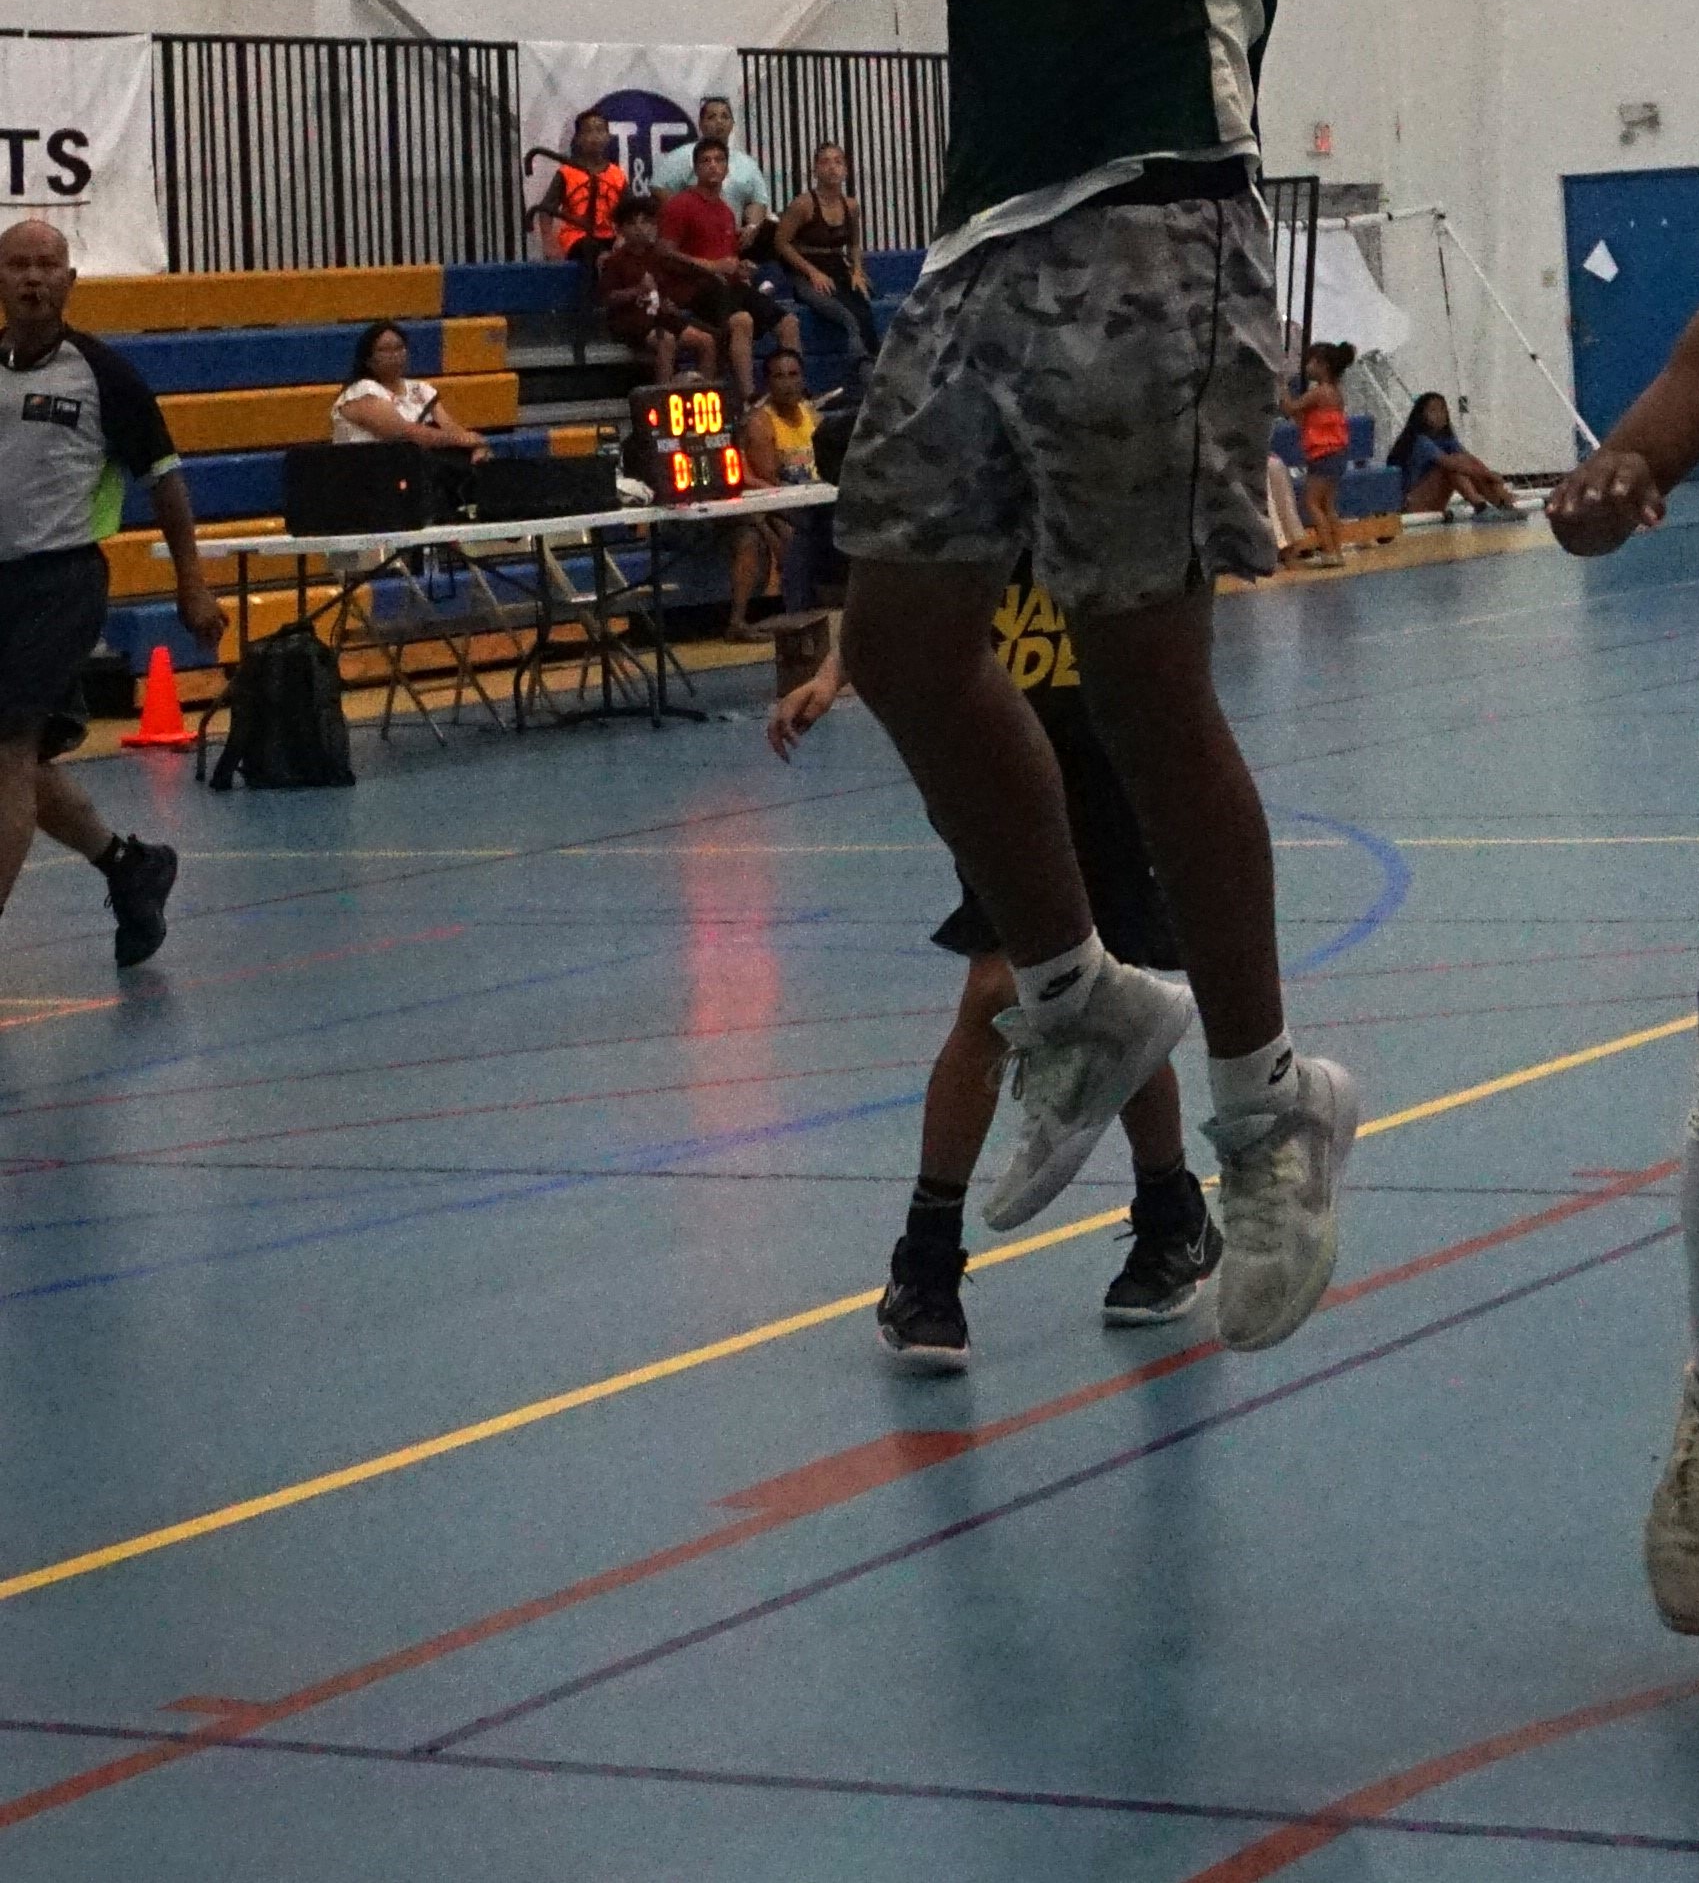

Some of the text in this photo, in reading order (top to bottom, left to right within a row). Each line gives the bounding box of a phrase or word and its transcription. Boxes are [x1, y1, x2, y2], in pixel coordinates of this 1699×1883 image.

[0, 127, 92, 196] TS
[669, 391, 723, 437] 8:00
[990, 580, 1067, 640] NA
